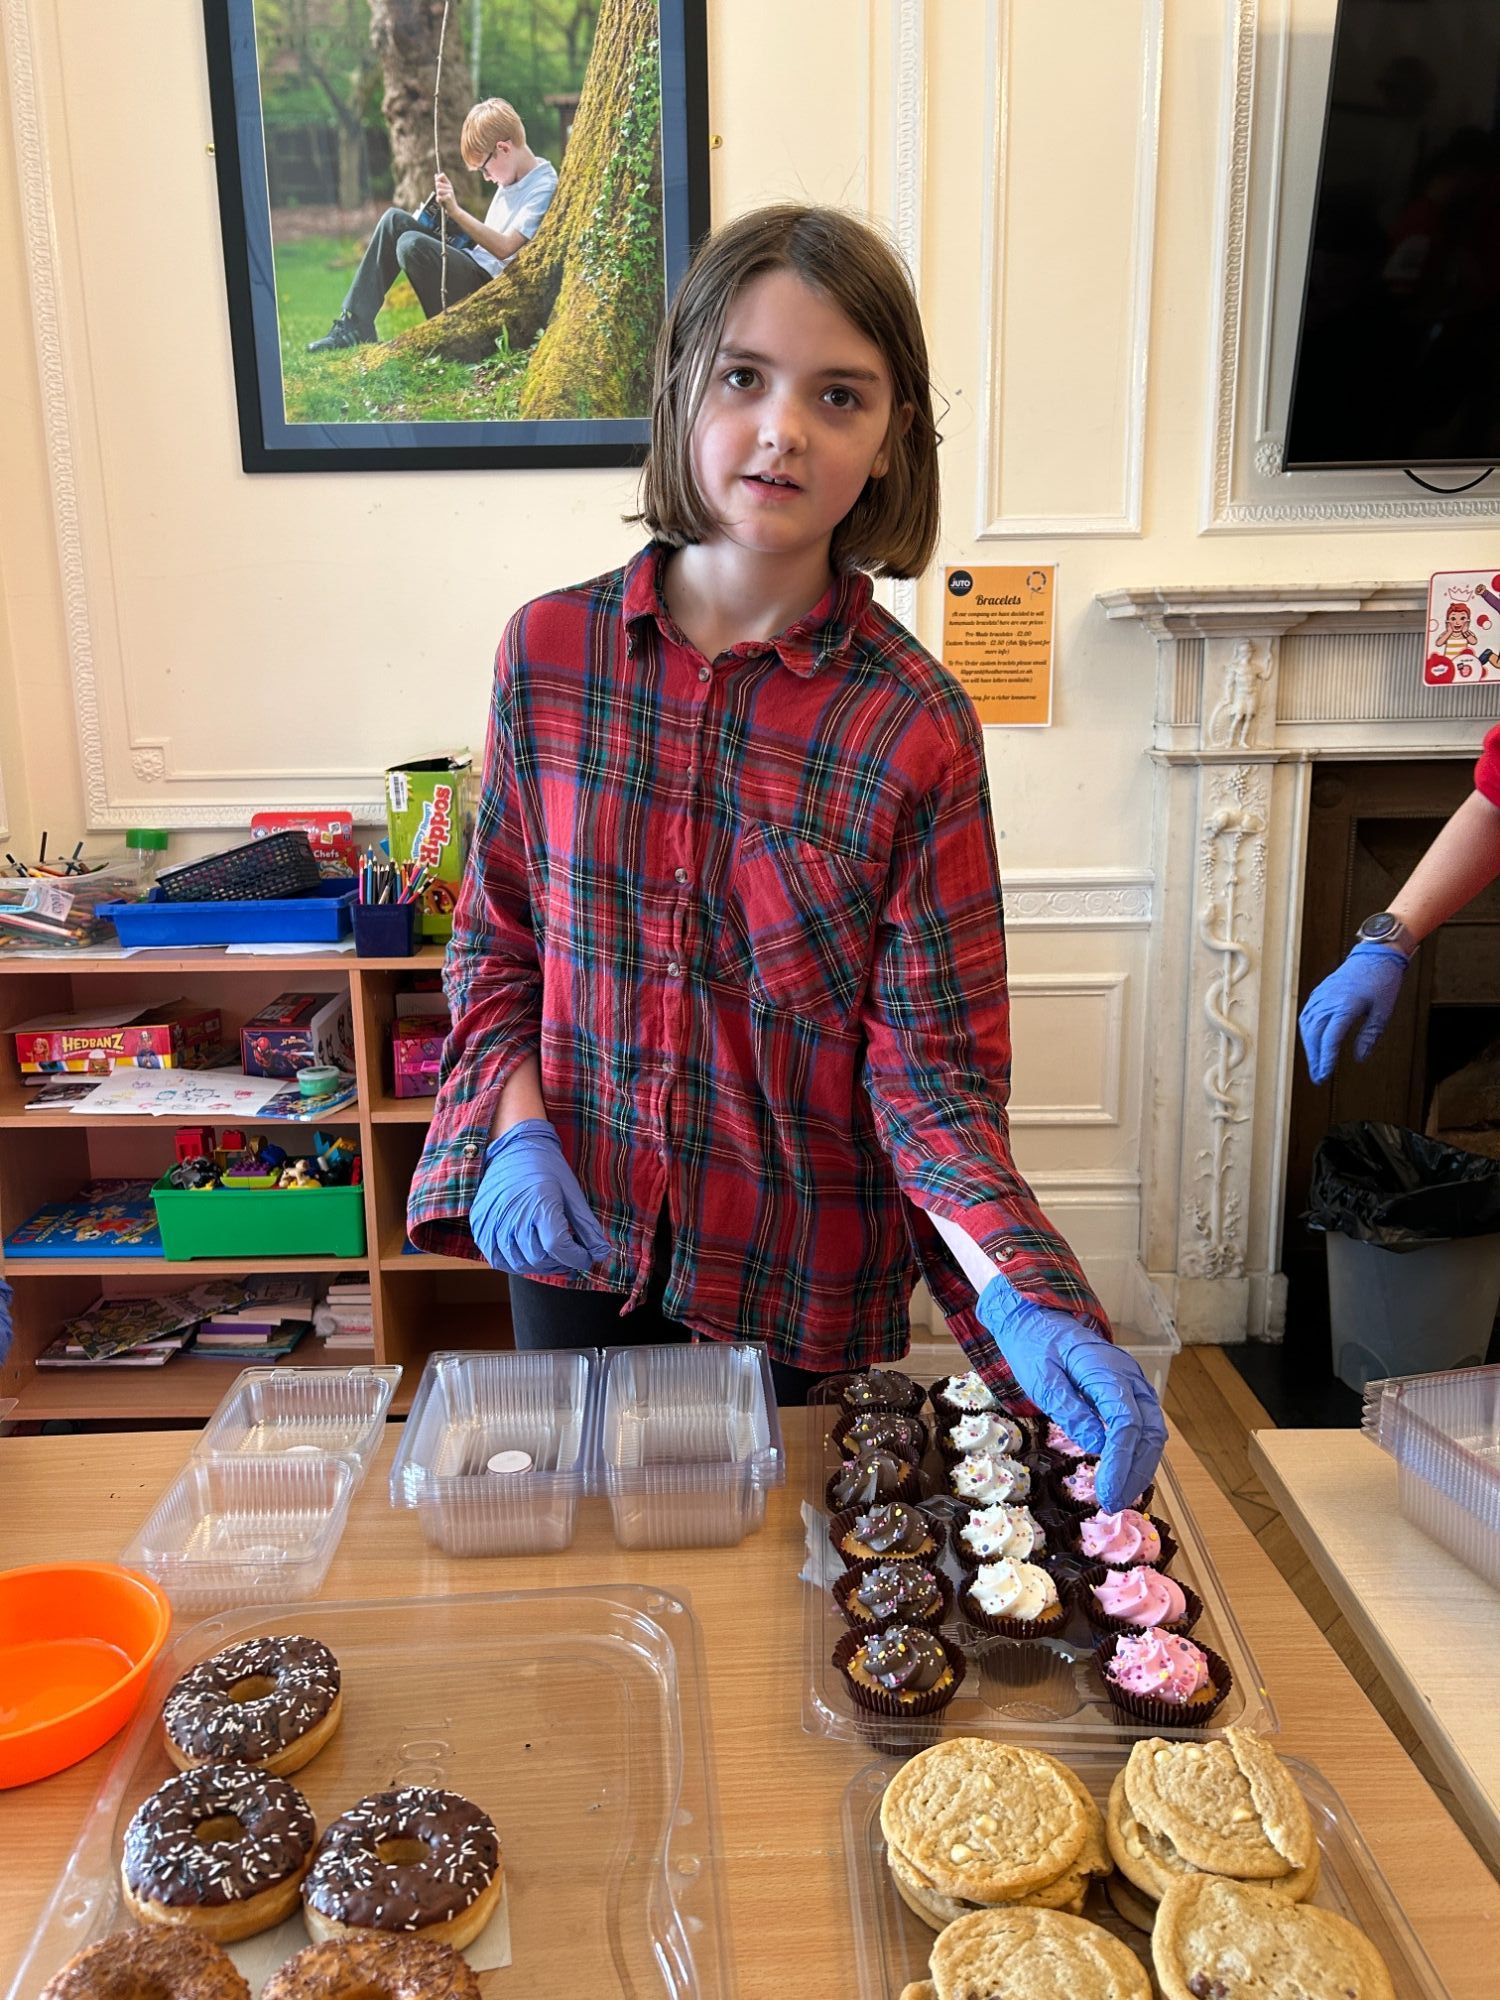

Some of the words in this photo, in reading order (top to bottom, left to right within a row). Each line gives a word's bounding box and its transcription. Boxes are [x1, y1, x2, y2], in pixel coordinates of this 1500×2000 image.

[975, 595, 1021, 605] Bracelets
[420, 786, 451, 865] Hippos
[313, 849, 340, 859] Chefs
[62, 1033, 125, 1052] HEDBANZ
